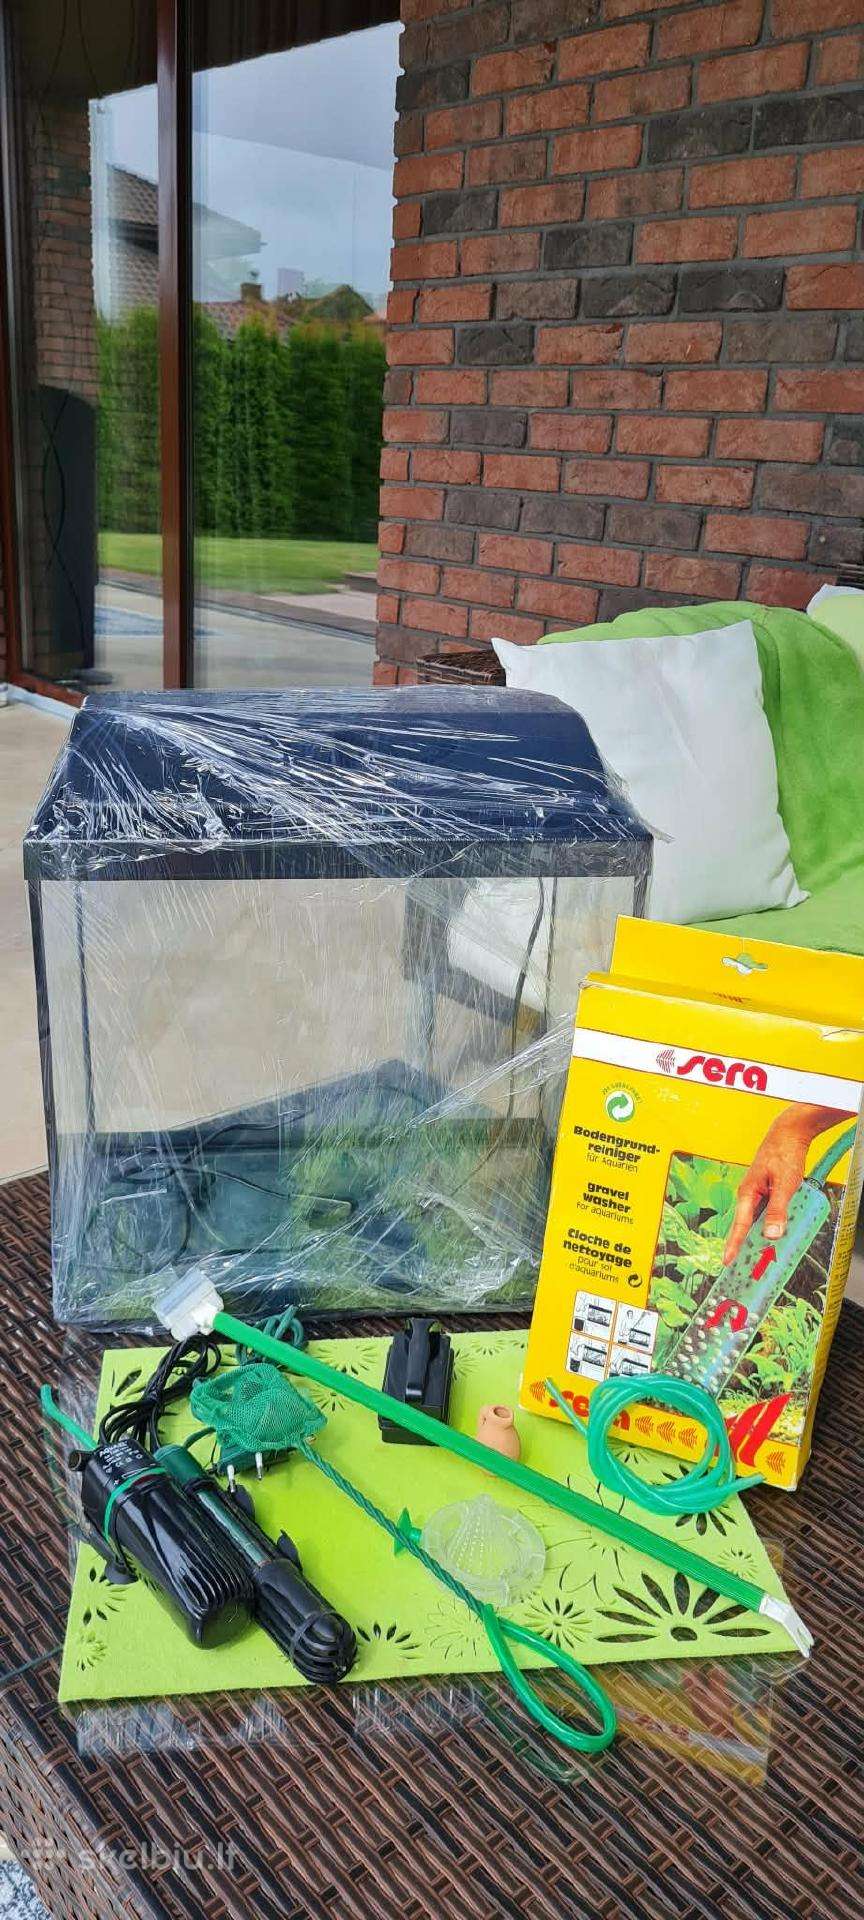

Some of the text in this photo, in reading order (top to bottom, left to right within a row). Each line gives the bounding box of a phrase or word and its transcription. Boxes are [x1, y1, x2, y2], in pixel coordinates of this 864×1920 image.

[677, 1055, 767, 1091] sera
[573, 1125, 660, 1154] Bodengrund-
[588, 1143, 641, 1163] reiniger
[602, 1157, 638, 1173] Aquarien
[587, 1182, 629, 1201] gravel
[583, 1192, 631, 1213] washer
[591, 1206, 634, 1224] aquariums
[568, 1228, 631, 1255] Cloche de
[563, 1240, 632, 1268] nettoyage
[577, 1256, 612, 1273] pour sol
[569, 1262, 619, 1283] d'aquariums
